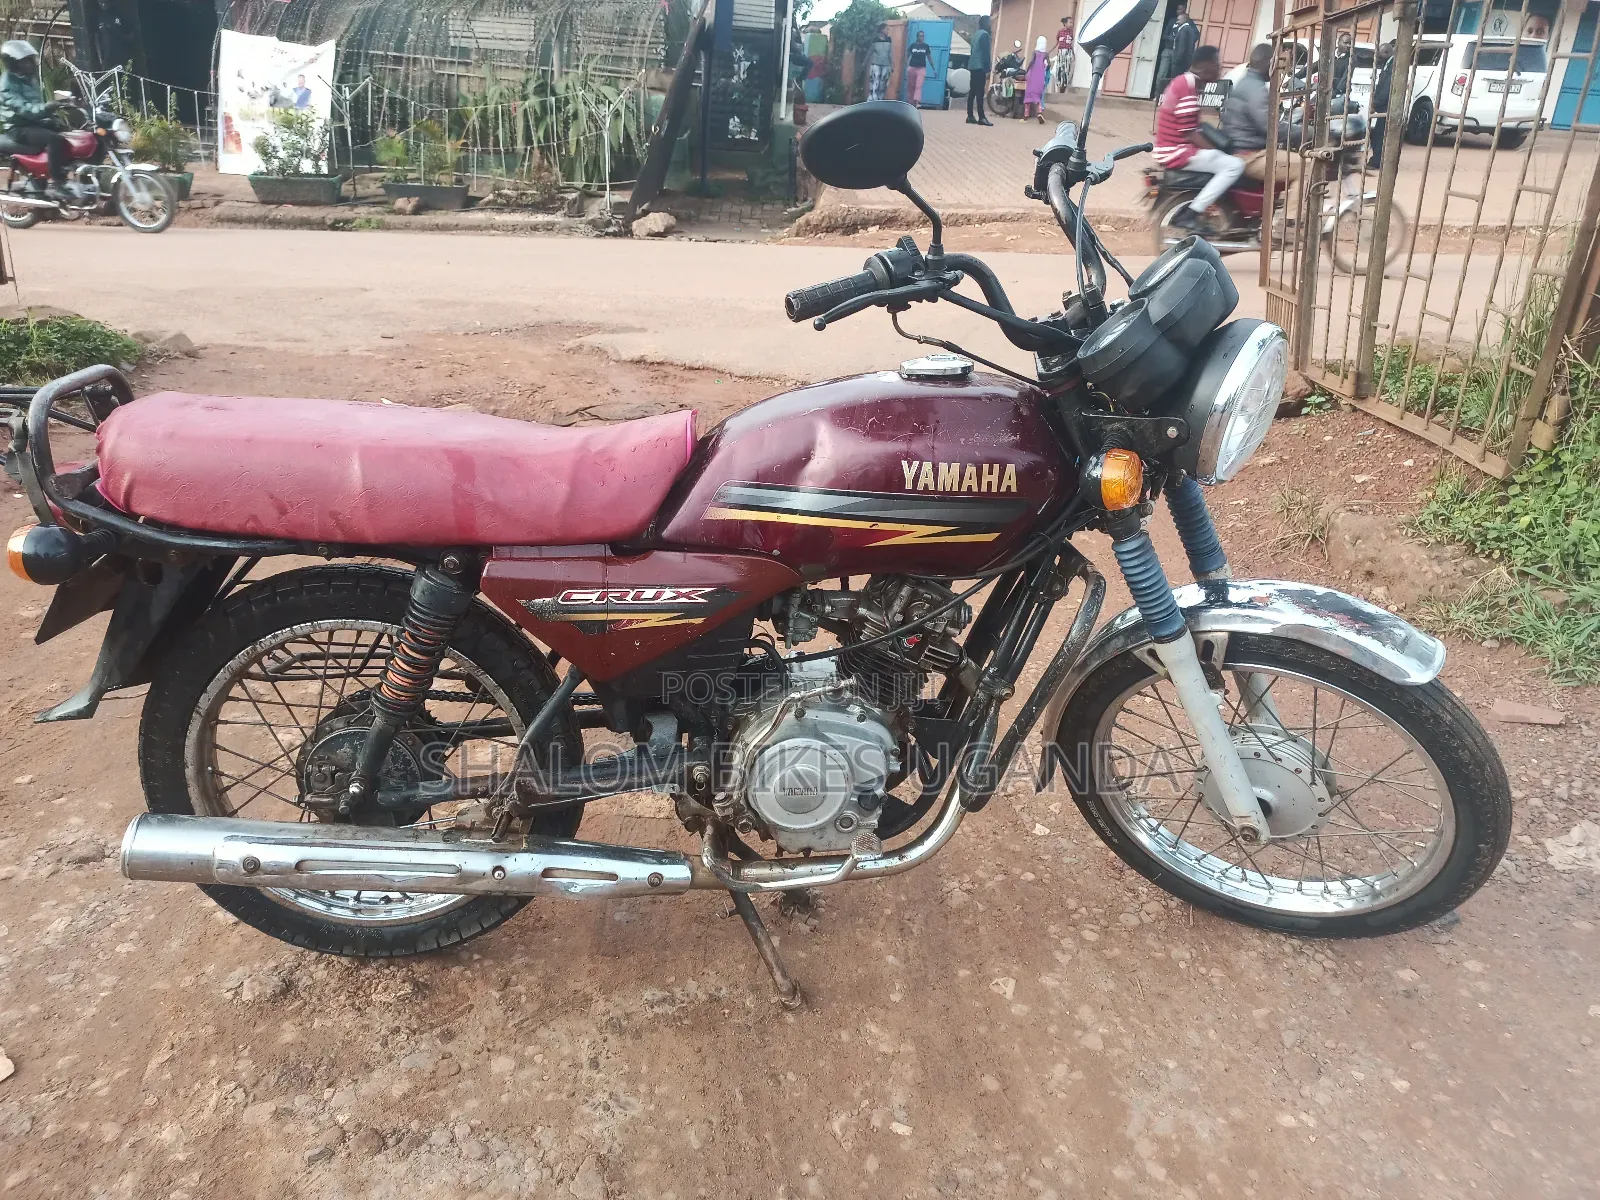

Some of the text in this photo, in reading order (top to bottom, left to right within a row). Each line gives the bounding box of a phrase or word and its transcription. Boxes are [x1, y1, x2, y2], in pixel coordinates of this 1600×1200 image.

[1204, 82, 1218, 93] NO
[1196, 94, 1224, 107] ARKING
[901, 460, 1017, 492] YAMAHA
[558, 588, 717, 604] CRUX
